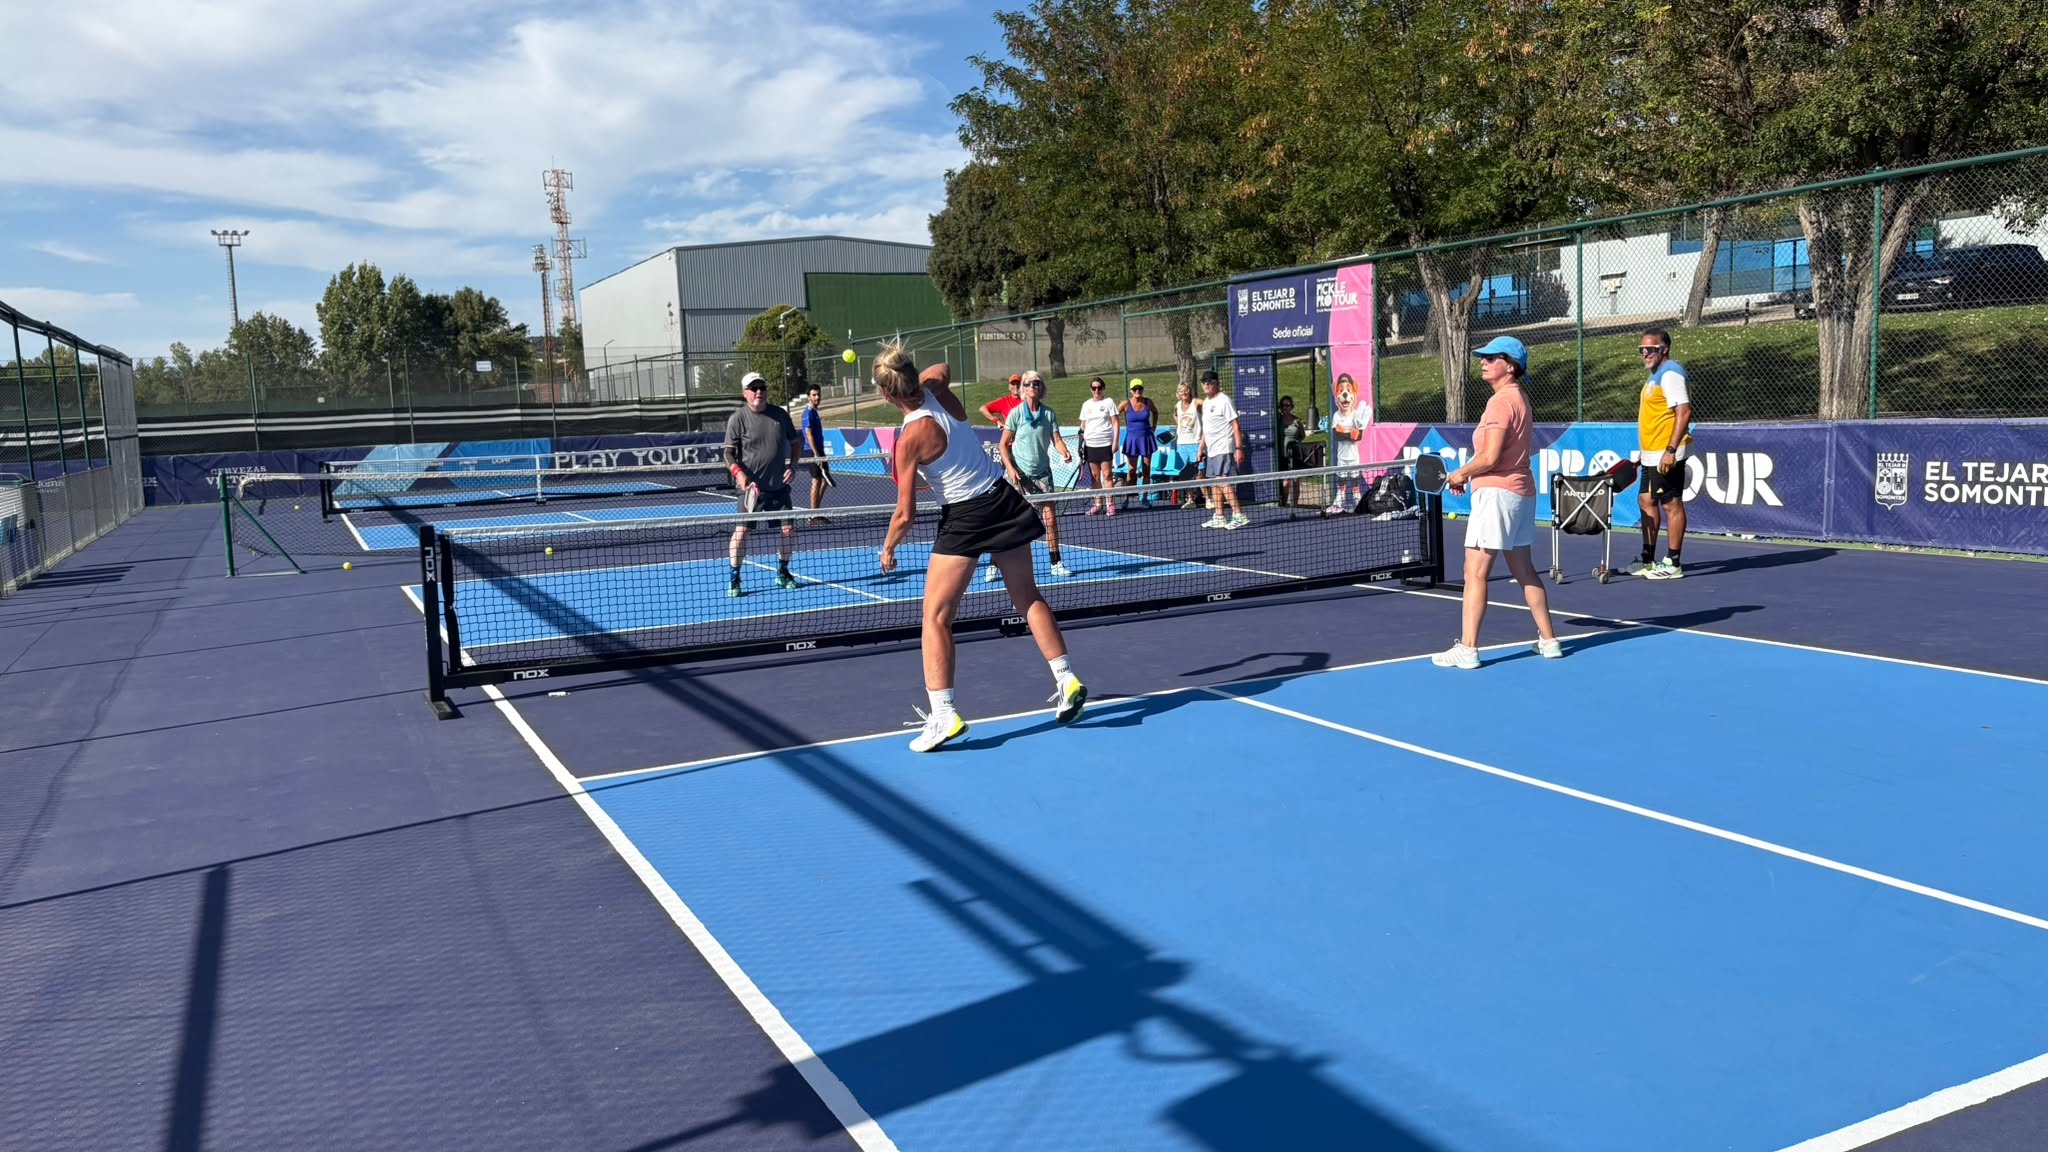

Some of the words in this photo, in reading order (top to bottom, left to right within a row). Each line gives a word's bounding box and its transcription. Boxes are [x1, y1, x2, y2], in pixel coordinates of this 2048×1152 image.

[1252, 291, 1262, 302] EL
[1263, 288, 1288, 300] TEJAR
[1332, 292, 1358, 306] TOUR
[1252, 299, 1296, 312] SOMONTES
[1272, 326, 1291, 339] Sede
[1292, 325, 1313, 337] oficial
[555, 451, 622, 470] PLAY
[631, 447, 700, 467] YOUR
[1925, 461, 1956, 481] EL
[1961, 461, 2048, 484] TEJAR
